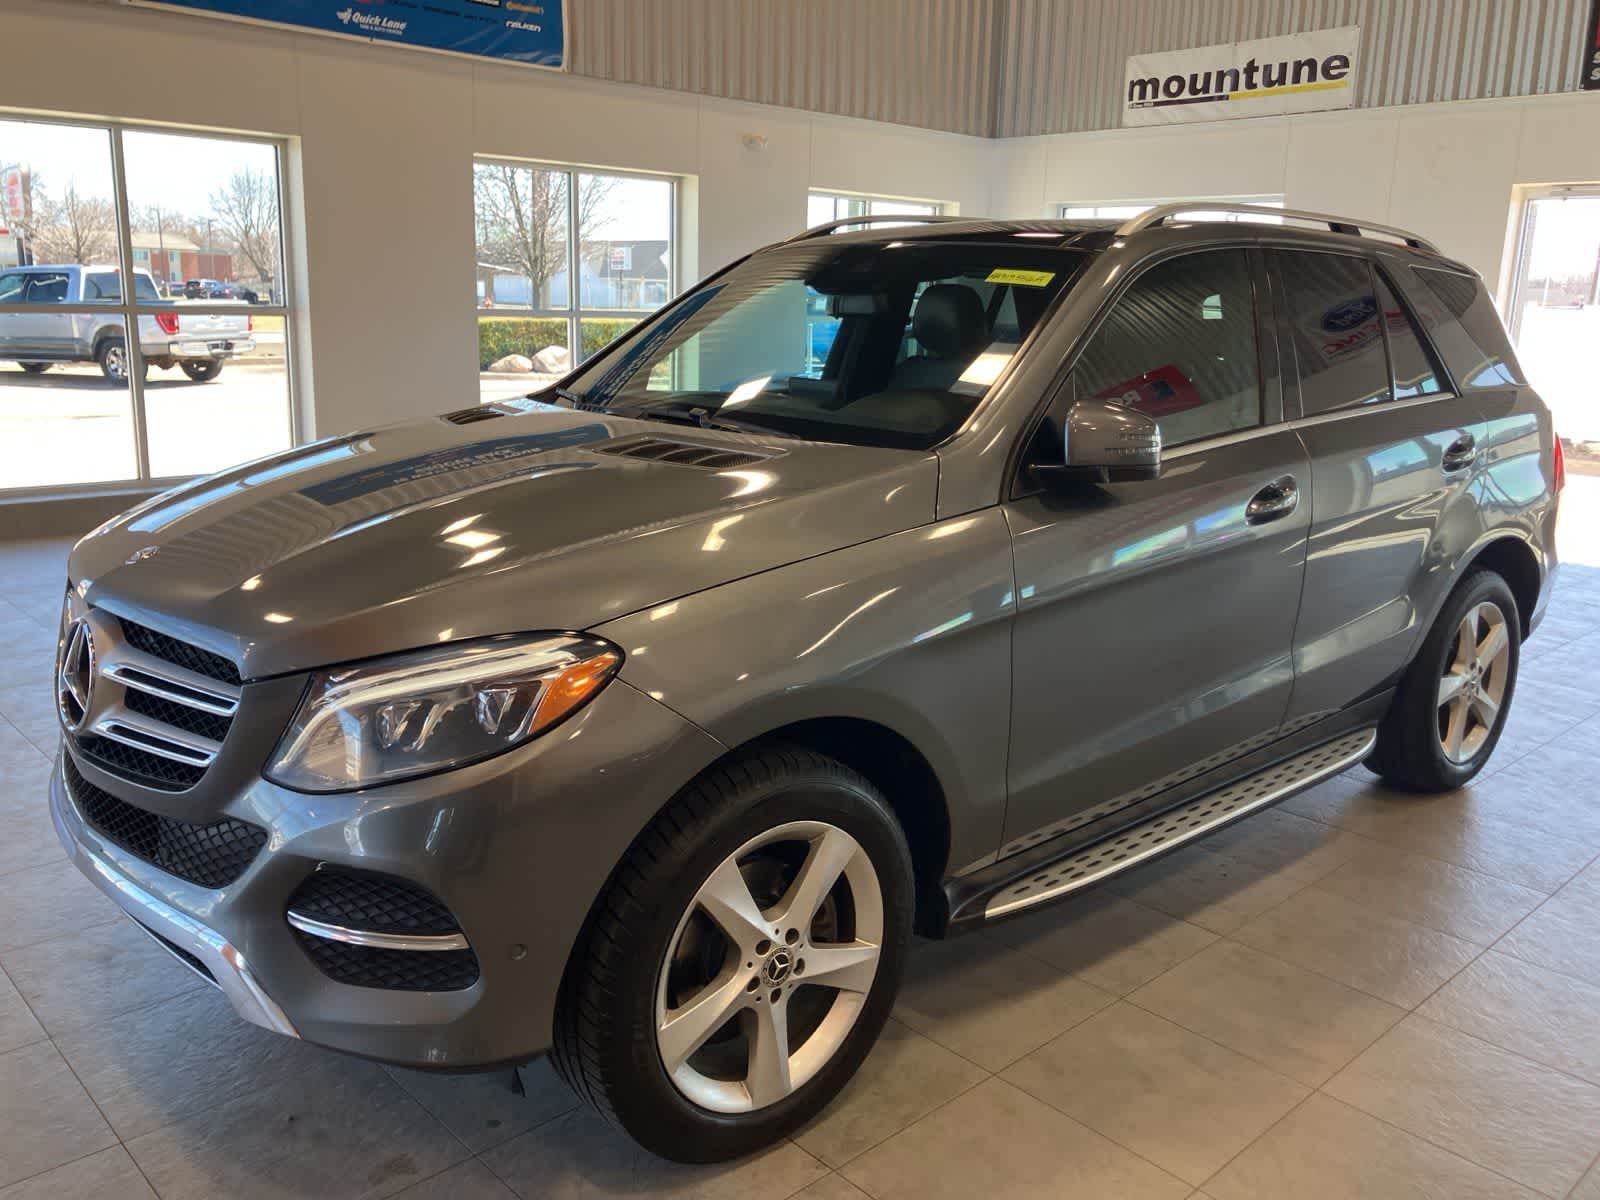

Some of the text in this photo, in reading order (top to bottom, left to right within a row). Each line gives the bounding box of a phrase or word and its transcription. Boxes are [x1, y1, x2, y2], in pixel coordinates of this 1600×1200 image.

[351, 11, 382, 25] Quick
[381, 17, 408, 30] Lane
[1128, 53, 1350, 102] mountune
